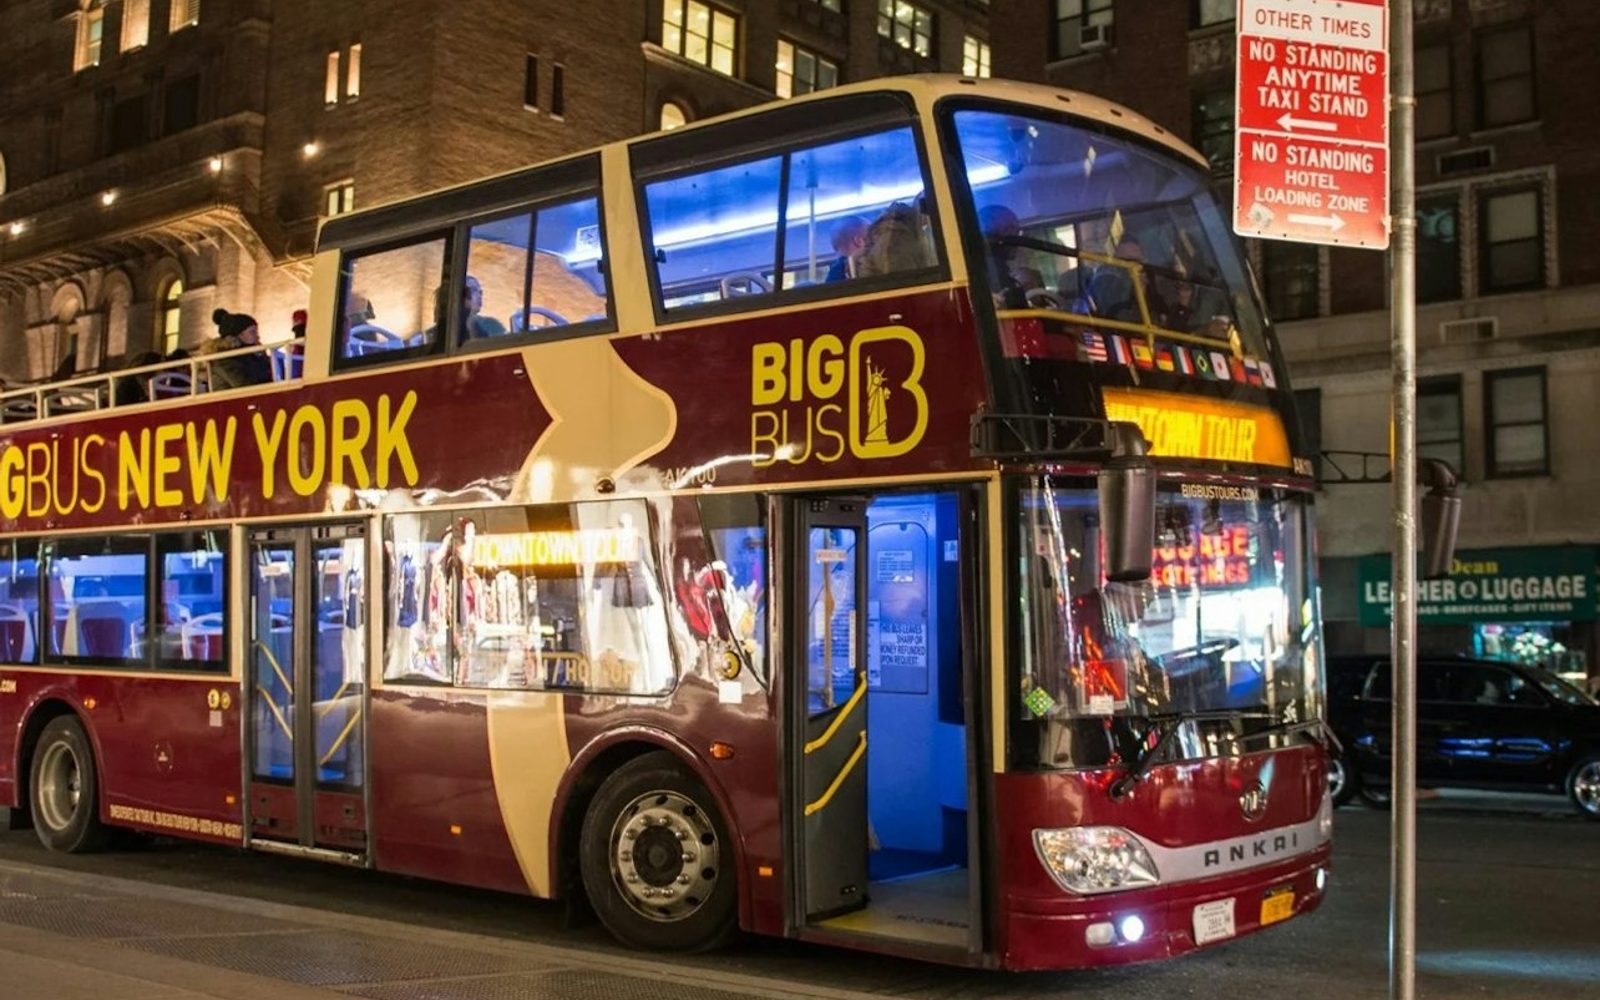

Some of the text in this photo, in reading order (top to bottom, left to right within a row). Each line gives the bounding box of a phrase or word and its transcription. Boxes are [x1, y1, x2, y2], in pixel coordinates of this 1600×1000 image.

[1255, 8, 1371, 38] OTHER TIMES
[1249, 41, 1377, 75] NO STANDING
[1265, 68, 1362, 96] ANYTIME
[1258, 86, 1369, 118] TAXI STAND
[1252, 141, 1374, 174] NO STANDING
[1285, 170, 1339, 190] HOTEL
[1254, 187, 1369, 213] LOADING ZONE
[752, 334, 845, 406] BIG
[751, 404, 845, 467] BUS
[1108, 403, 1257, 462] TOWN TOUR
[118, 416, 237, 510] NEW
[252, 390, 419, 499] YORK
[1181, 483, 1259, 501] BIGBUSTOURS.COM
[474, 532, 580, 565] DOWNTOWN
[1449, 558, 1499, 575] Dean
[1364, 579, 1457, 603] LEHER
[1481, 575, 1587, 600] LUGGAGE
[1204, 832, 1297, 866] ANKAI
